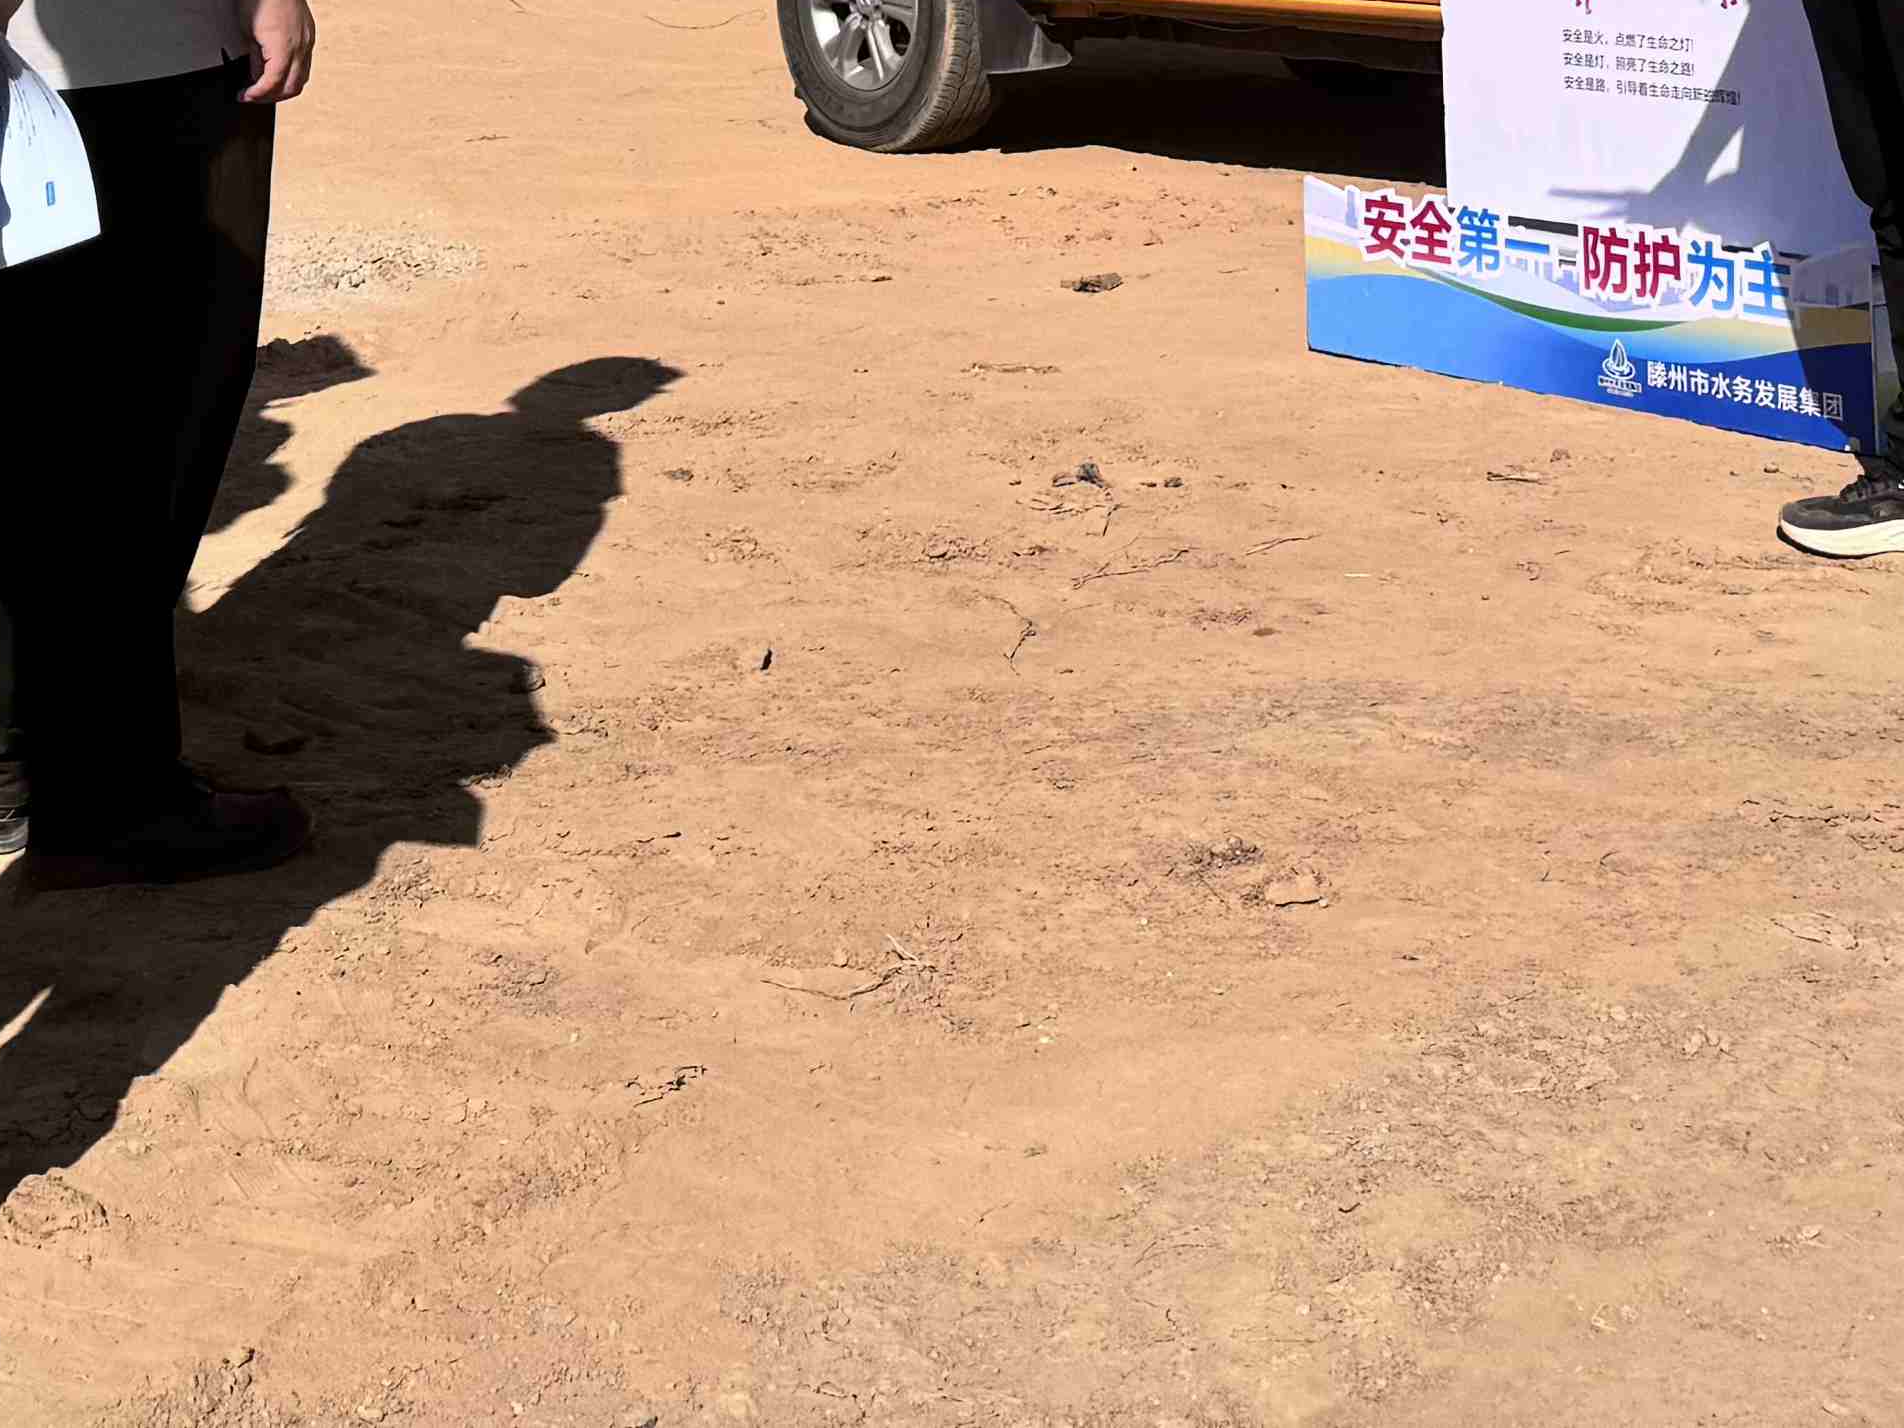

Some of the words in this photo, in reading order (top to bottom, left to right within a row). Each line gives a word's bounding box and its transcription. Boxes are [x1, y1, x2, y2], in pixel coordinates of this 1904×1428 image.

[1647, 360, 1844, 421] 滕州市水务发展集团
